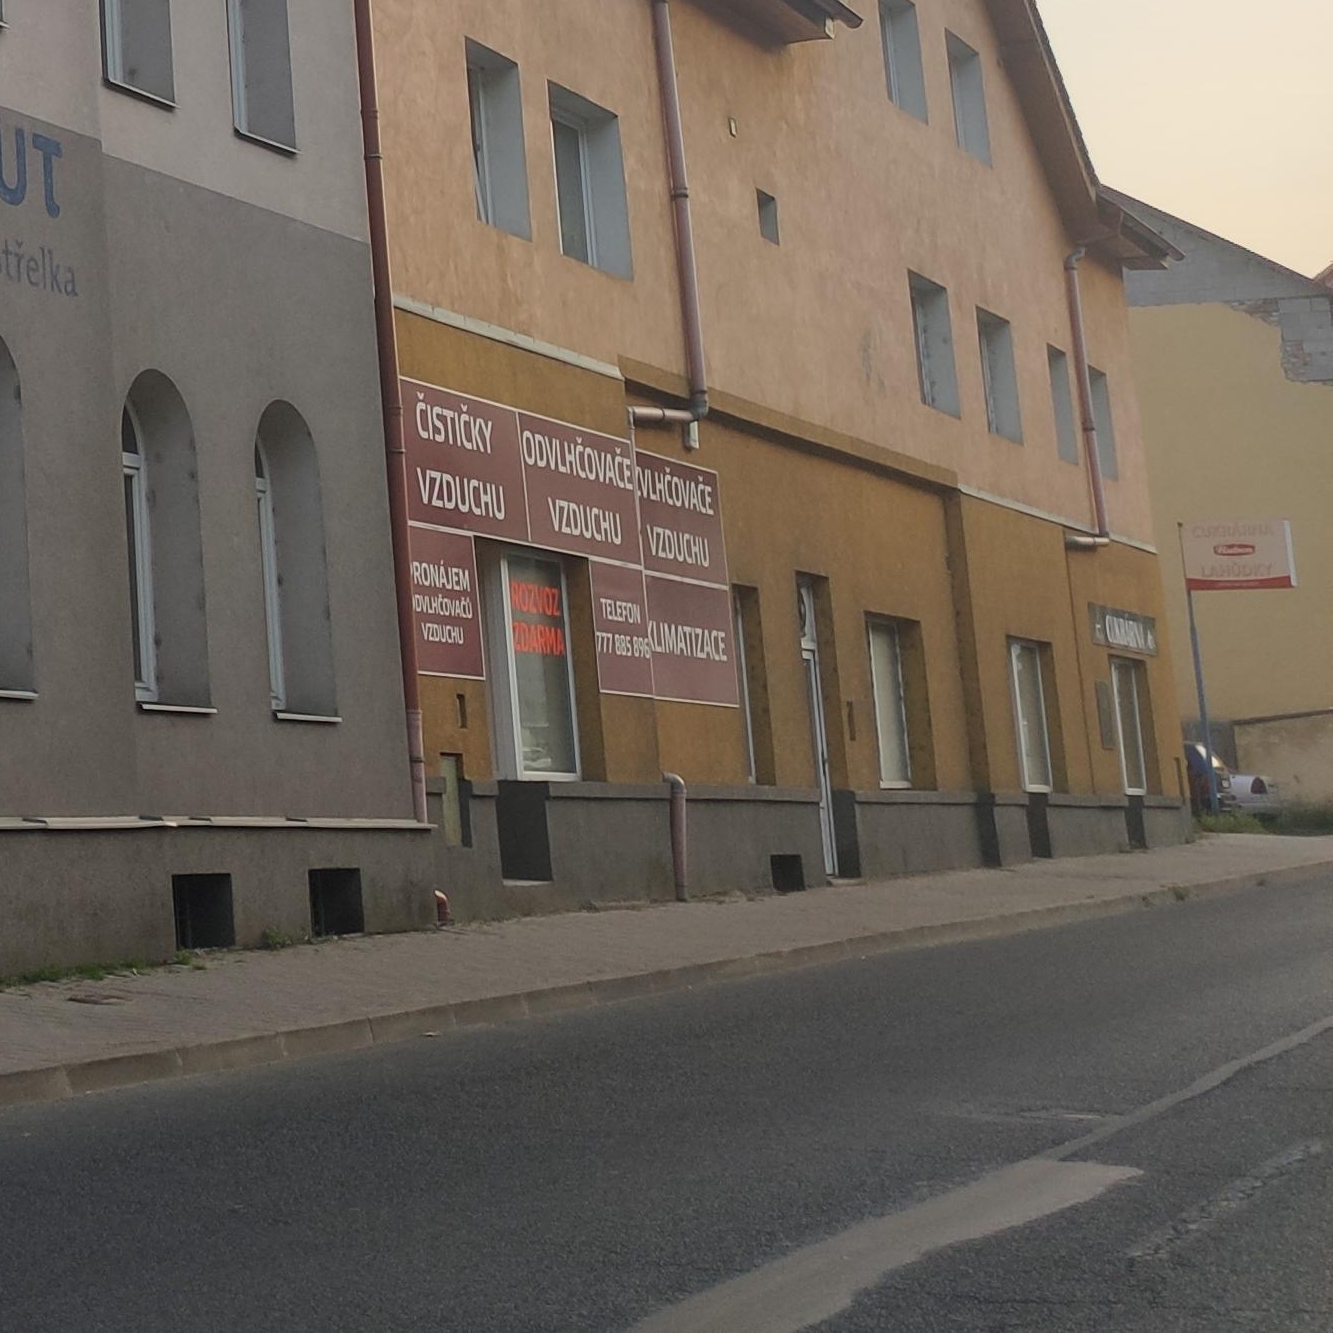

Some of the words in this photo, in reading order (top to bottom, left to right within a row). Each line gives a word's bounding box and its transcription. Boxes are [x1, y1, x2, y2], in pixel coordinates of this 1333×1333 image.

[416, 391, 492, 454] ČISTIČKY
[522, 430, 634, 491] ODVLHČOVAČE
[416, 467, 505, 520] VZDUCHU
[548, 497, 622, 545] VZDUCHU
[646, 524, 709, 567] VZDUCHU
[411, 559, 471, 593] RONÁJEM
[413, 593, 473, 619] DVLHČOVAČŮ
[510, 578, 561, 616] ROZVOZ
[600, 598, 641, 624] TELEFON
[421, 622, 464, 645] VZDUCHU
[512, 621, 565, 656] ZDARMA
[596, 632, 613, 654] 777
[614, 634, 632, 657] 885
